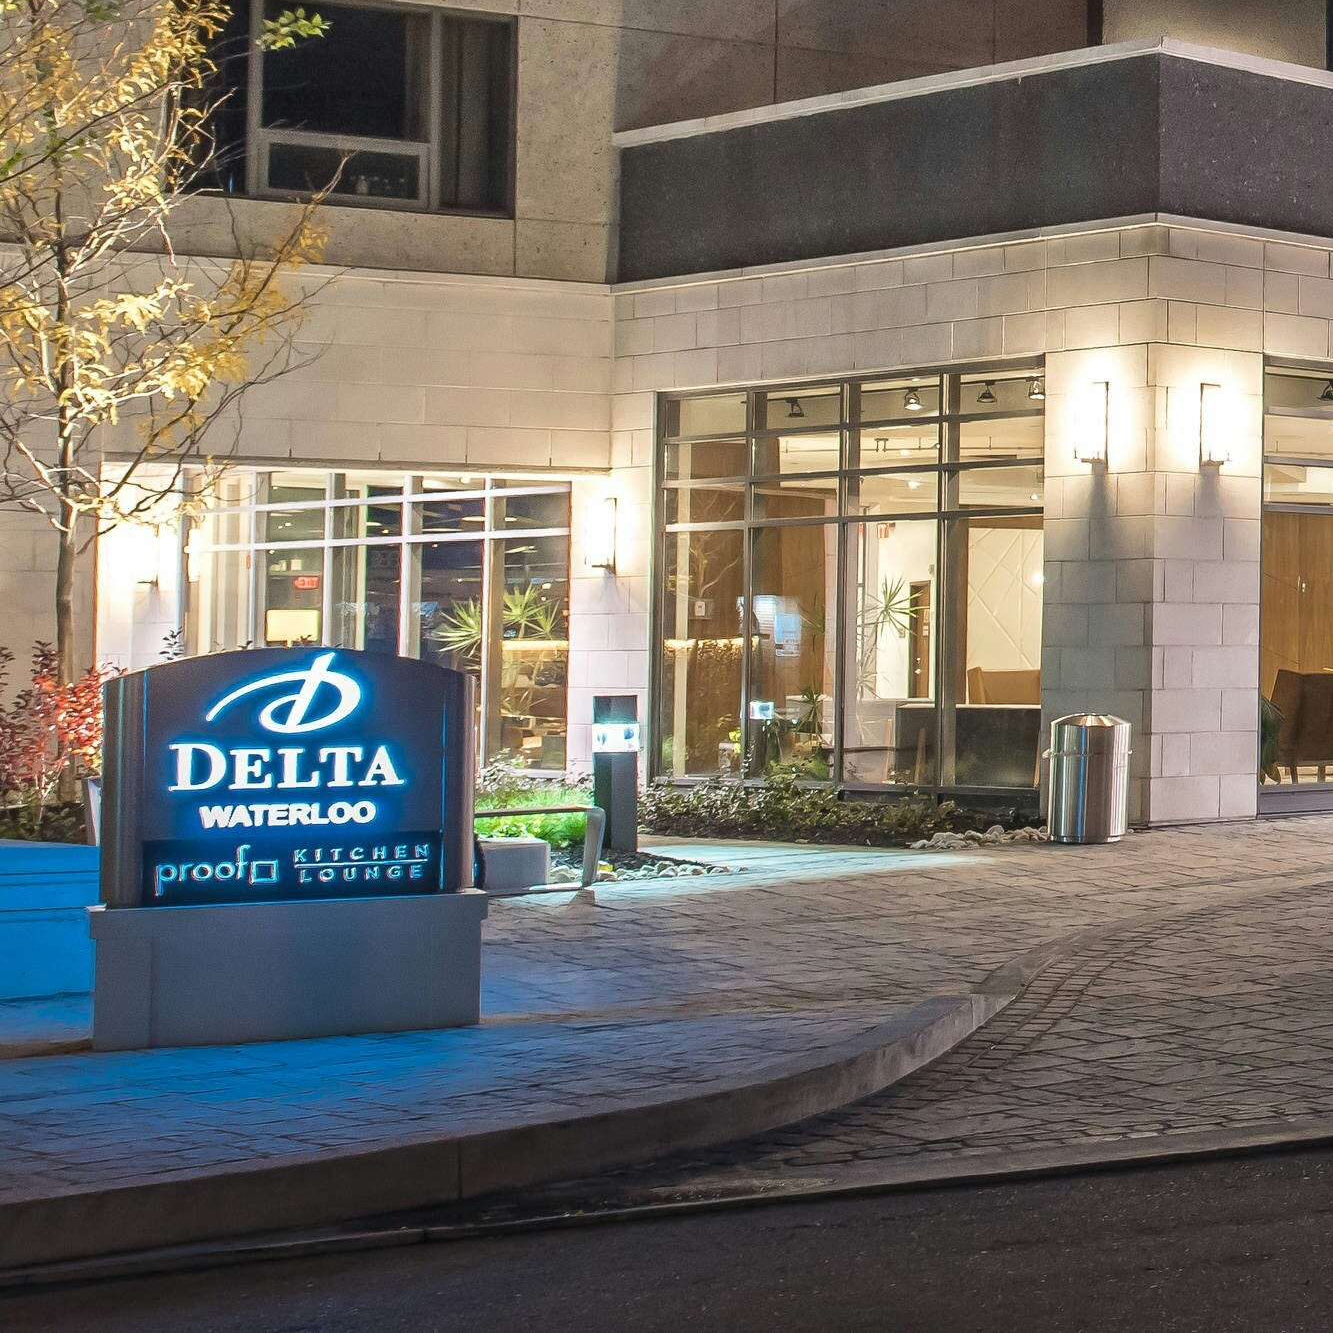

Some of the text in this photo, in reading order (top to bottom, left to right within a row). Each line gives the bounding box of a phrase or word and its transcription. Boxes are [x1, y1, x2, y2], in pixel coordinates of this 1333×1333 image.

[168, 743, 405, 792] DELTA
[199, 800, 377, 829] WATERLOO
[293, 843, 430, 864] KITCHEN
[154, 843, 251, 897] proof
[298, 864, 424, 884] LOUNGE
